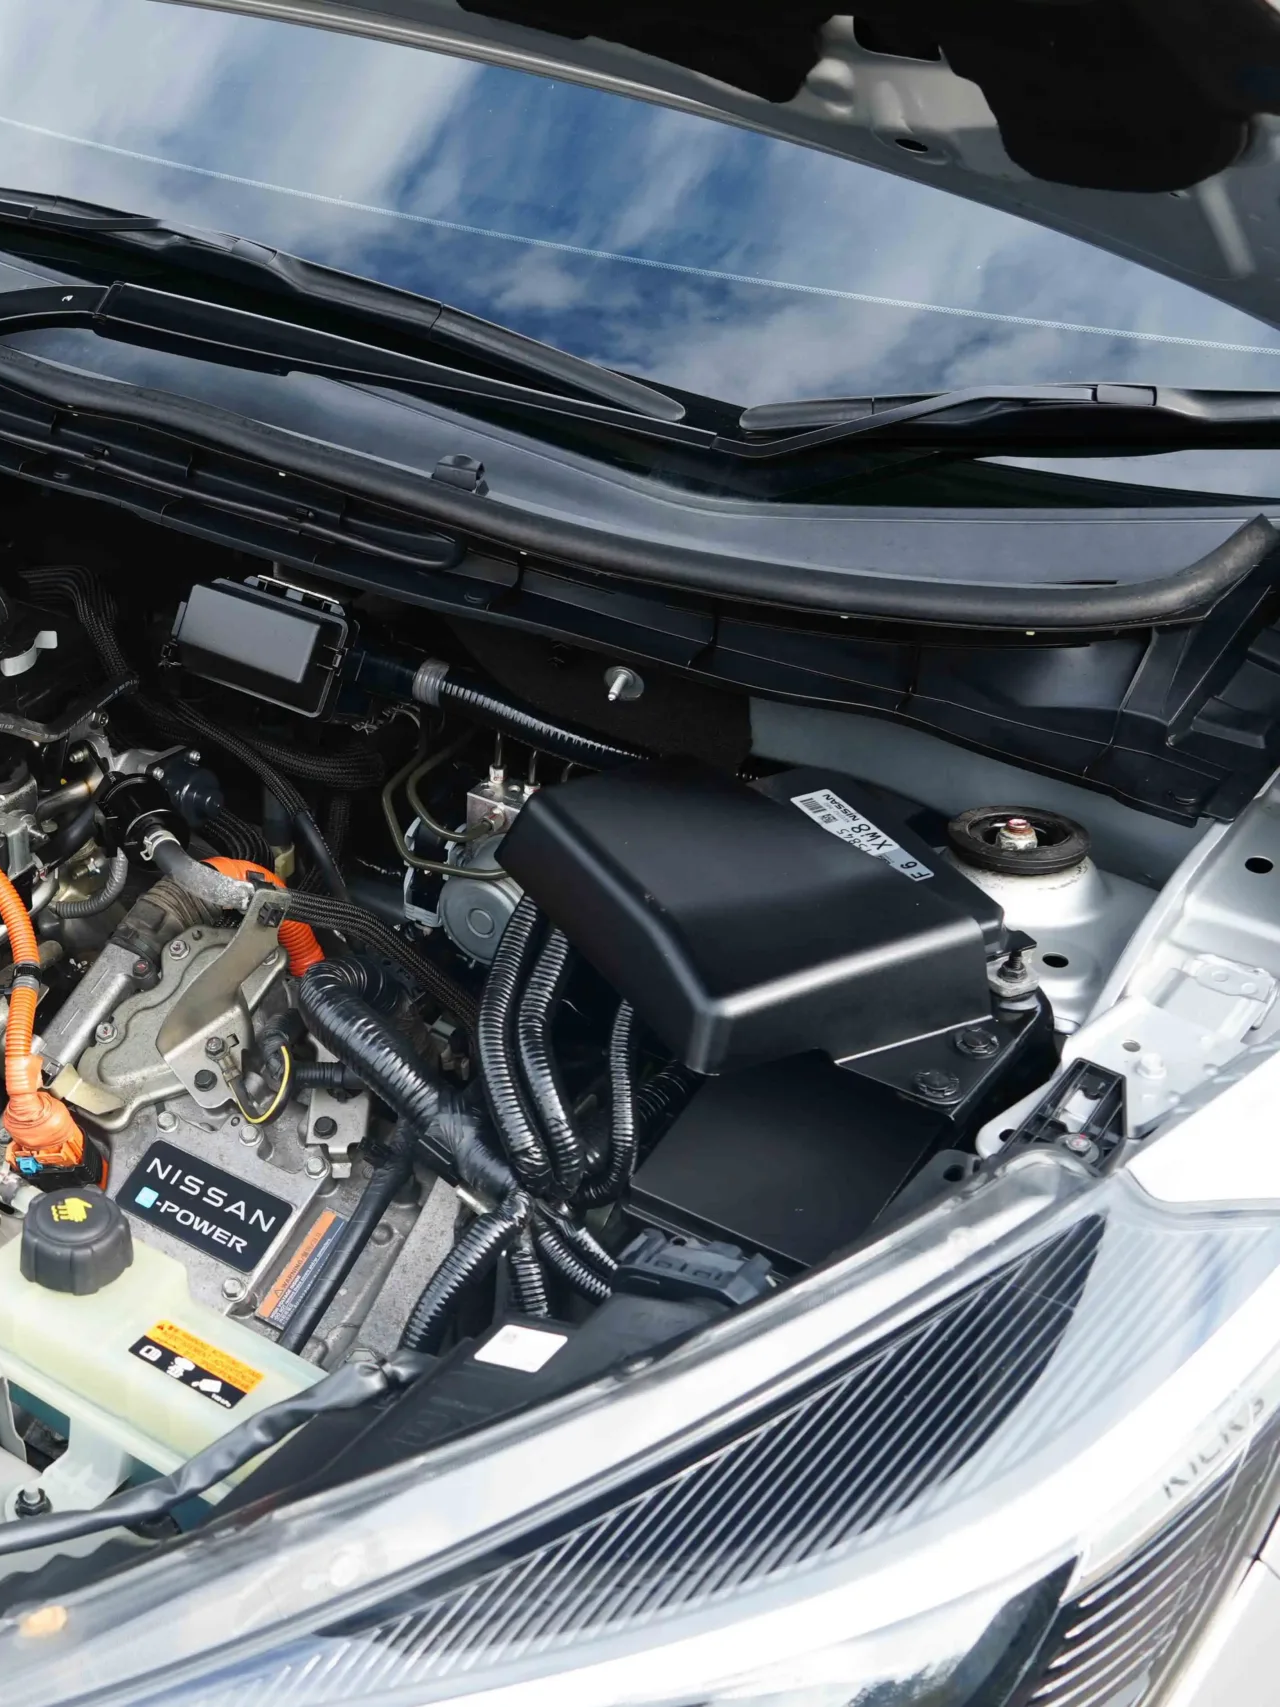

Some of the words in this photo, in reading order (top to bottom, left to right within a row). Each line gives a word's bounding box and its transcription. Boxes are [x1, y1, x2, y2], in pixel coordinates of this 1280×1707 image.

[822, 793, 860, 822] NISSAN
[851, 823, 892, 850] XW8
[900, 861, 917, 869] 6
[145, 1157, 276, 1233] NISSAN
[134, 1186, 248, 1253] -POWER
